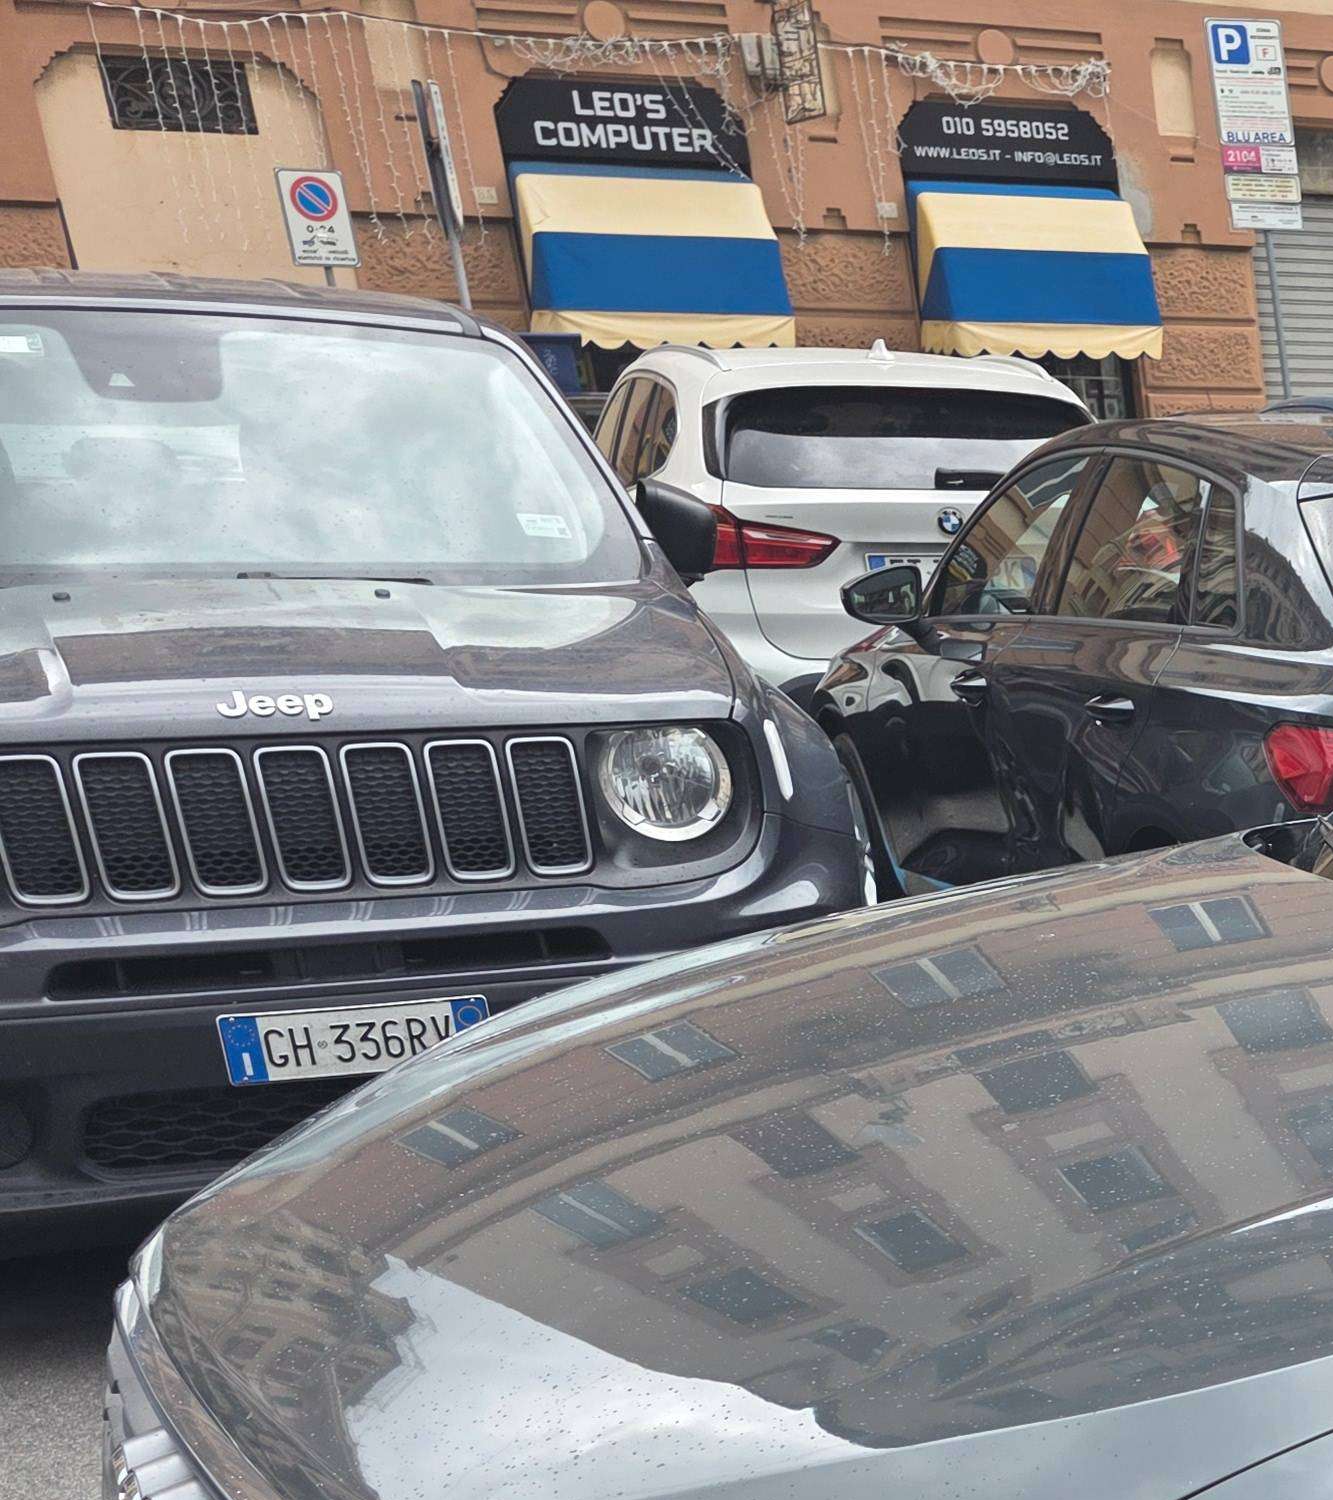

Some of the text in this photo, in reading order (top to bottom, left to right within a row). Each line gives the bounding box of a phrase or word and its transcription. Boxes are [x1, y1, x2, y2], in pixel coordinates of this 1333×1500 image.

[1217, 28, 1242, 61] P
[572, 90, 667, 120] LEO'S
[533, 120, 718, 154] COMPUTER
[942, 116, 1070, 141] 010 5958052
[1226, 131, 1287, 144] BLU AREA
[914, 145, 1001, 162] WWW.LEOS.IT
[1014, 151, 1102, 166] INFO@LEOS.IT
[216, 690, 334, 721] Jeep
[263, 1025, 317, 1069] GH
